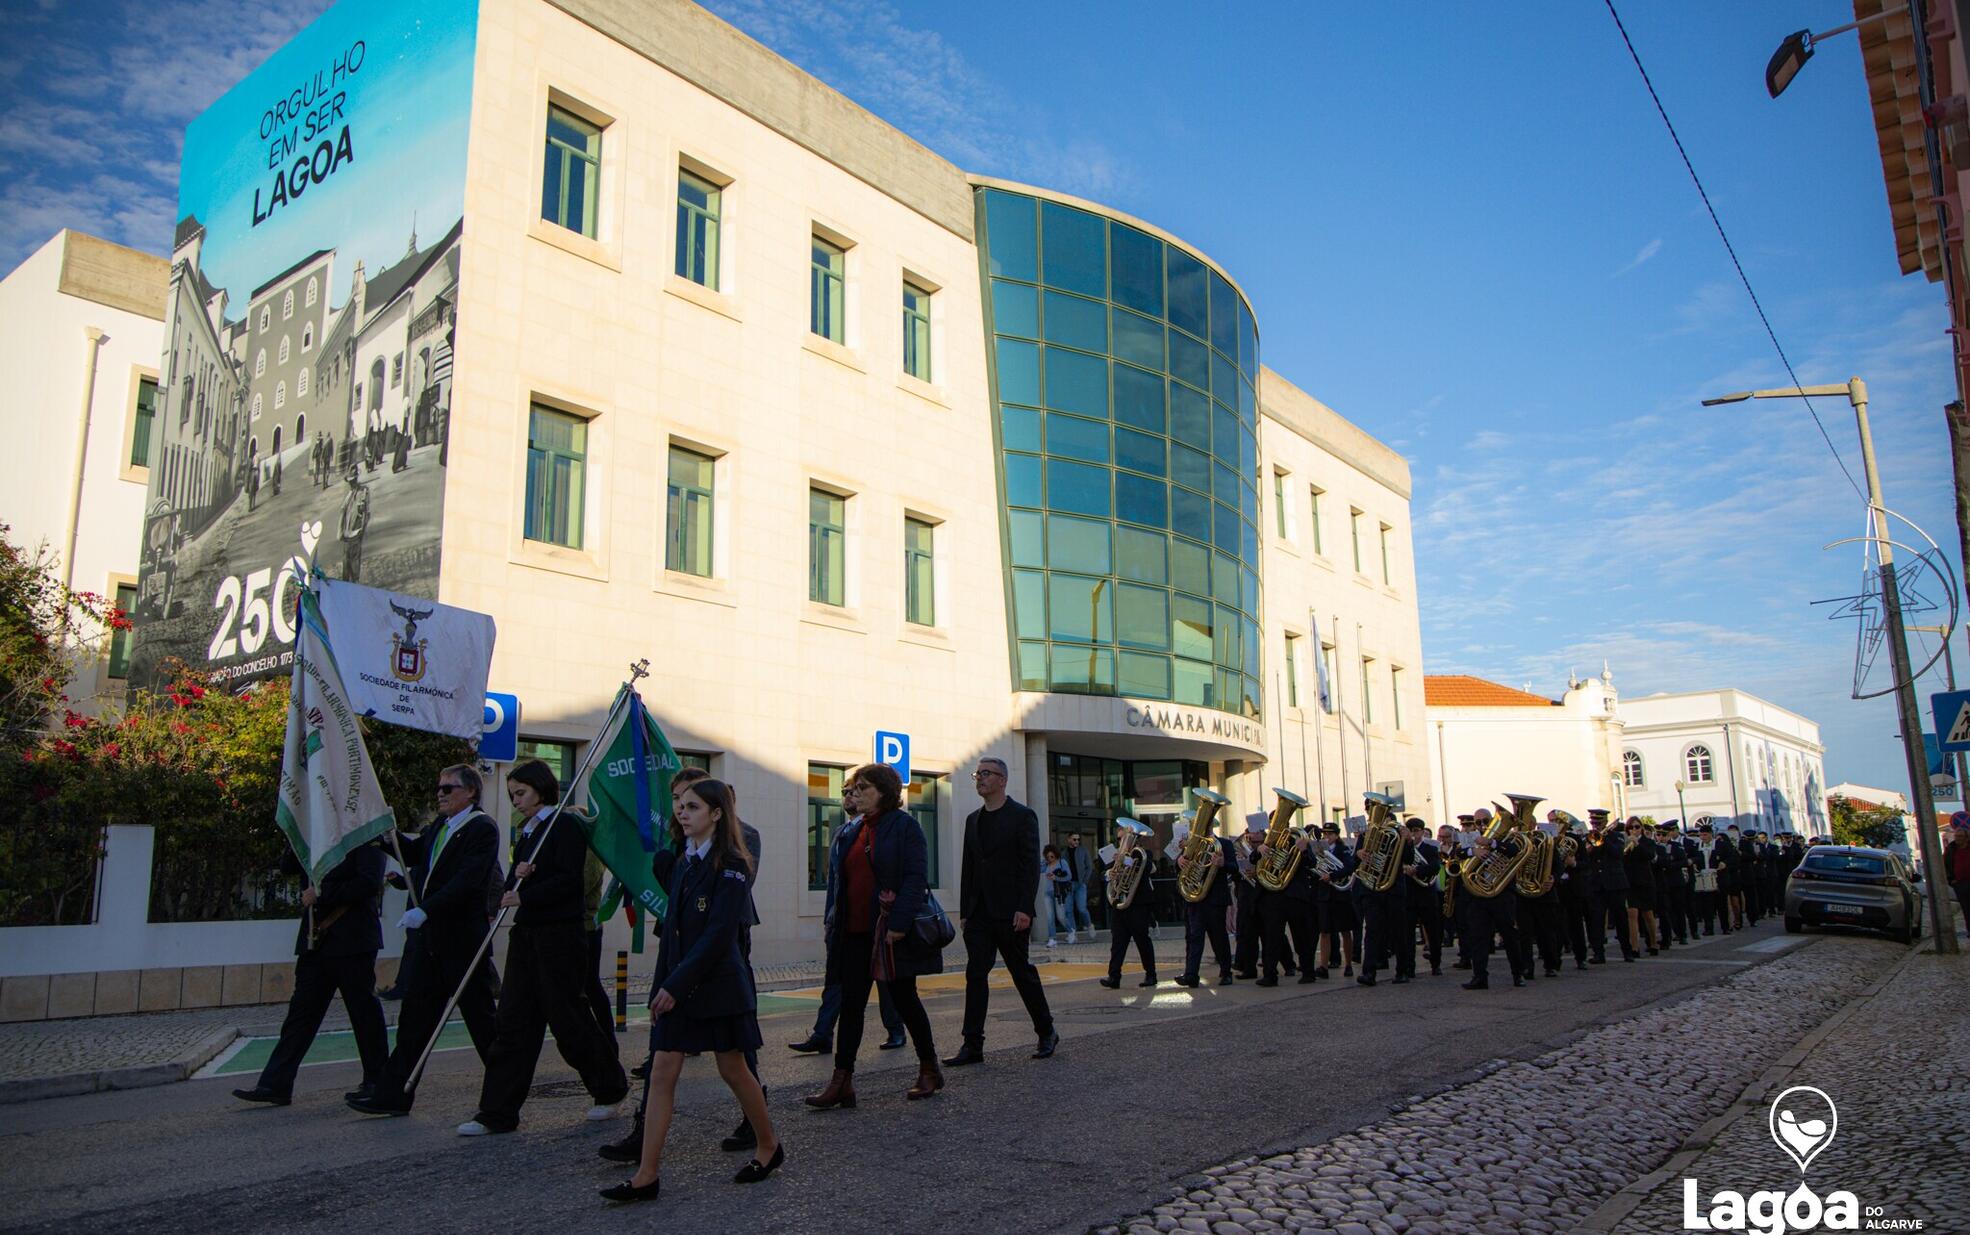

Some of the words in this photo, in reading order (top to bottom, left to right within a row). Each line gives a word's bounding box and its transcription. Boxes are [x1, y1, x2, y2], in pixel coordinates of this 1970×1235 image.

[260, 40, 366, 140] ORGULHO
[268, 126, 298, 170] EM
[303, 91, 346, 142] SER
[252, 124, 354, 227] LAGOA
[208, 556, 310, 661] 250
[232, 666, 242, 677] DO
[242, 655, 278, 675] CONCELHO
[360, 672, 400, 690] SOCIEDADE
[401, 683, 454, 700] FILARMÓNICA
[400, 694, 410, 703] DE
[391, 704, 415, 715] SERPA
[1126, 705, 1205, 733] CÂMARA
[883, 736, 903, 767] P
